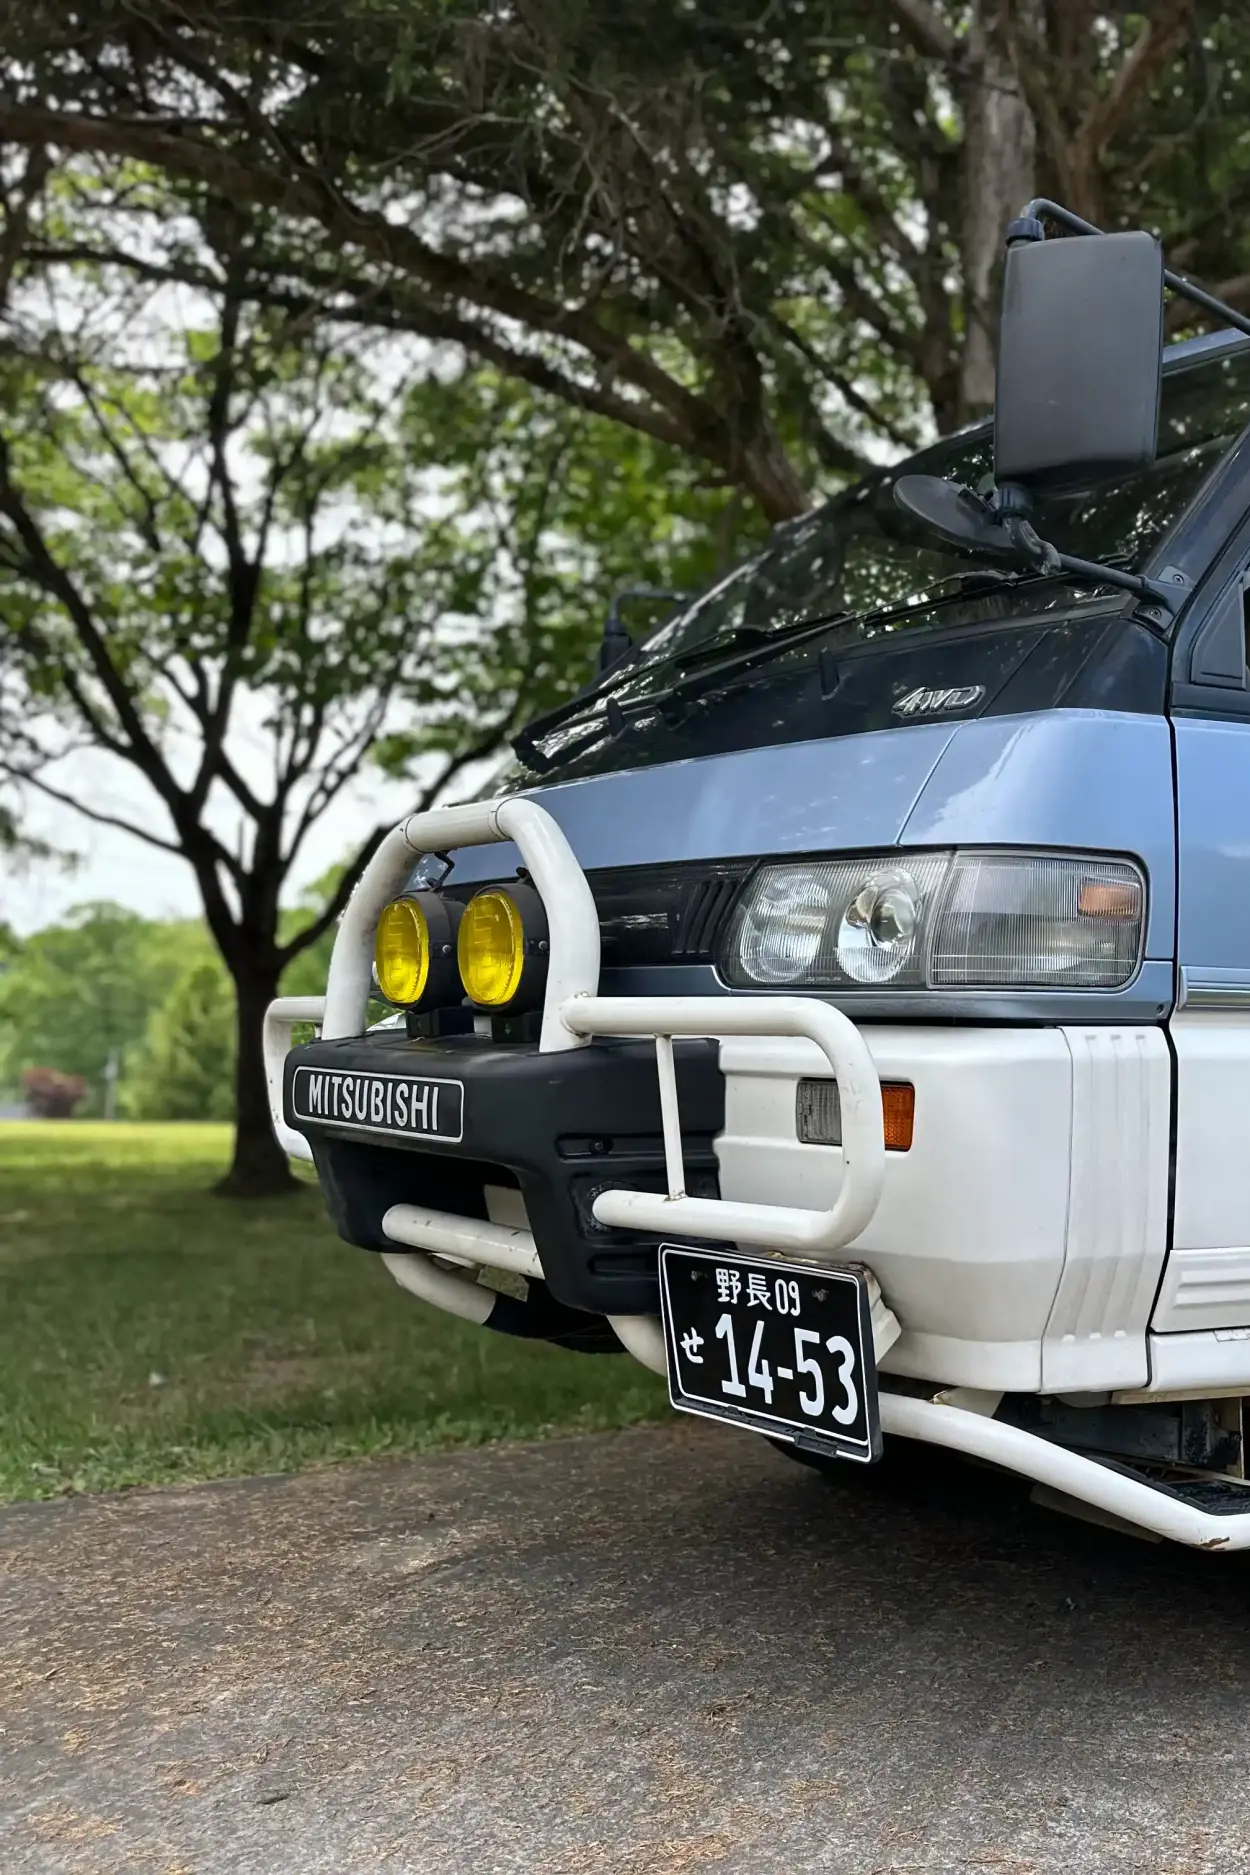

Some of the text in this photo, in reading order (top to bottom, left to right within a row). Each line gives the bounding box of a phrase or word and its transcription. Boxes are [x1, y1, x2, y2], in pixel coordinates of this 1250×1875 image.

[892, 686, 984, 716] 4WD
[308, 1073, 439, 1131] MITSUBISHI
[679, 1313, 859, 1426] せ 14-53
